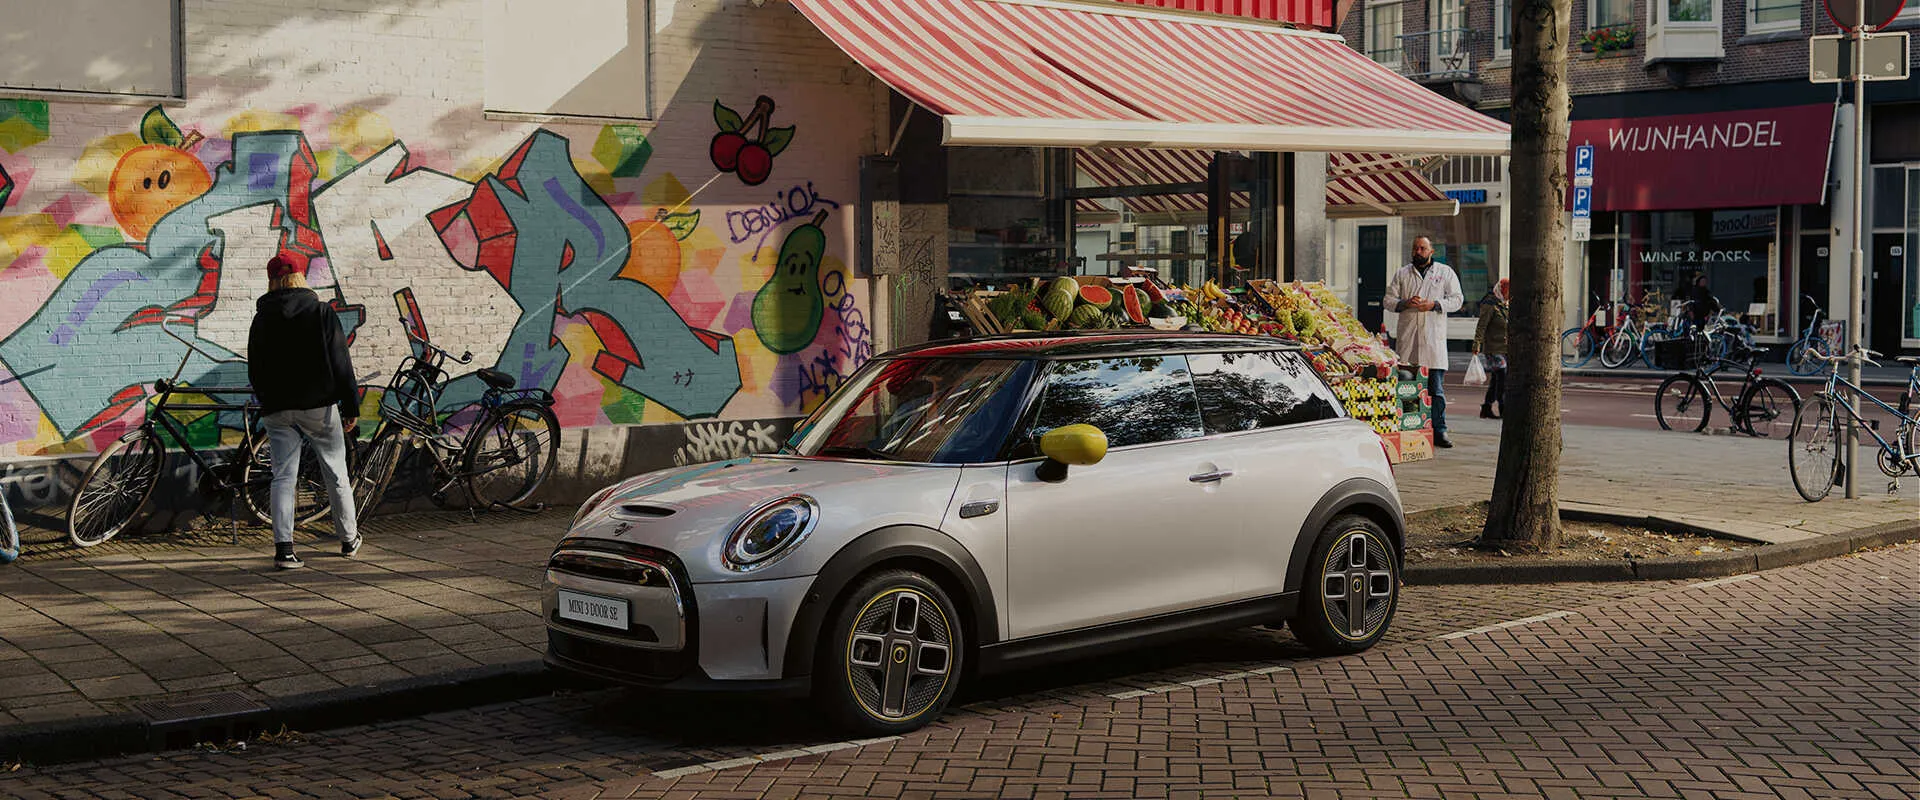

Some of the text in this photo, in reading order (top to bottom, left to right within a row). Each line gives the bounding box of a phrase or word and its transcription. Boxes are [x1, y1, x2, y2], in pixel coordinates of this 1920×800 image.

[1608, 121, 1782, 151] WIJNHANDEL
[1578, 148, 1590, 165] P
[1576, 189, 1588, 205] P
[1639, 250, 1683, 263] WINE
[568, 599, 618, 620] MINI 3 DOOR SE
